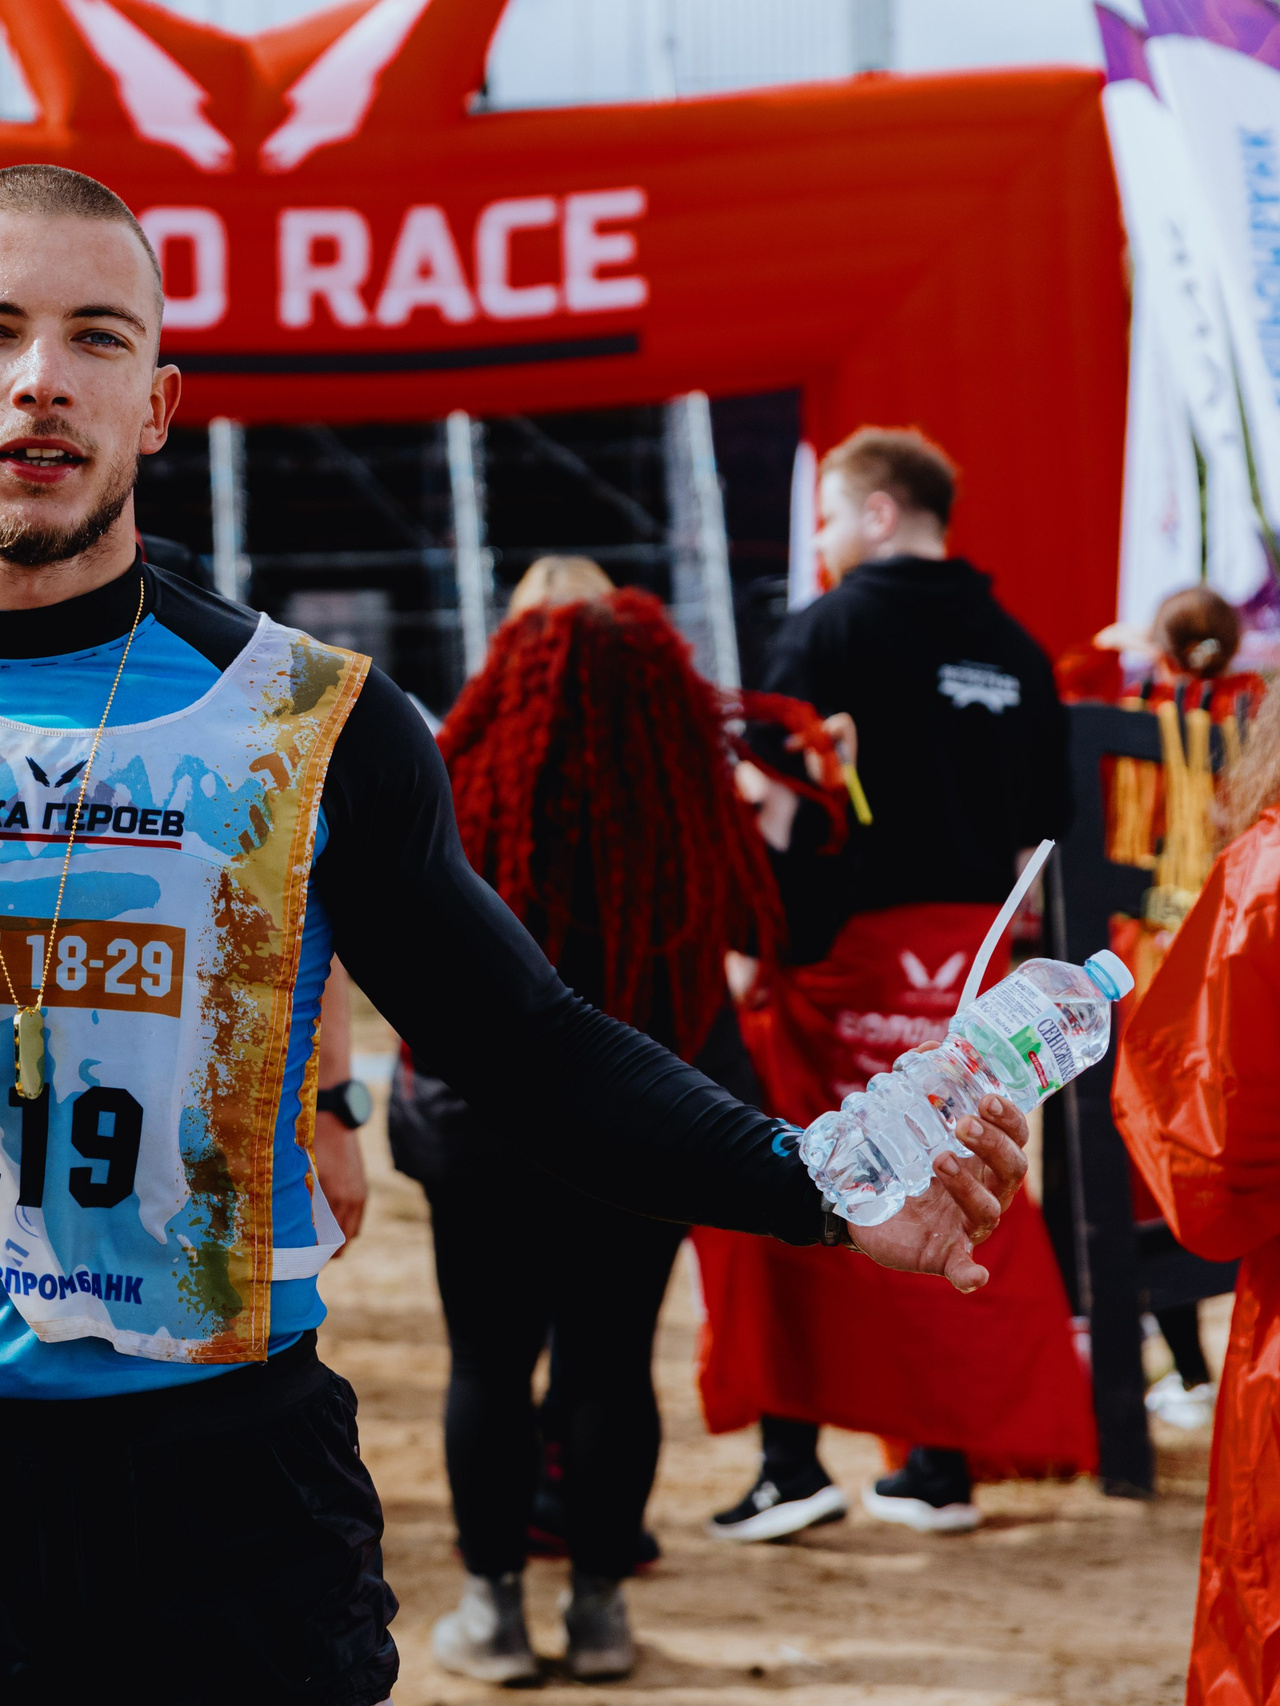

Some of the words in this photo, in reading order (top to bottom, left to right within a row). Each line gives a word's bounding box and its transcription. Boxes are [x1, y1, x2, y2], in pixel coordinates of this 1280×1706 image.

[278, 186, 648, 328] RACE
[42, 802, 185, 837] ГЕРОЕВ
[26, 934, 173, 998] 18-29
